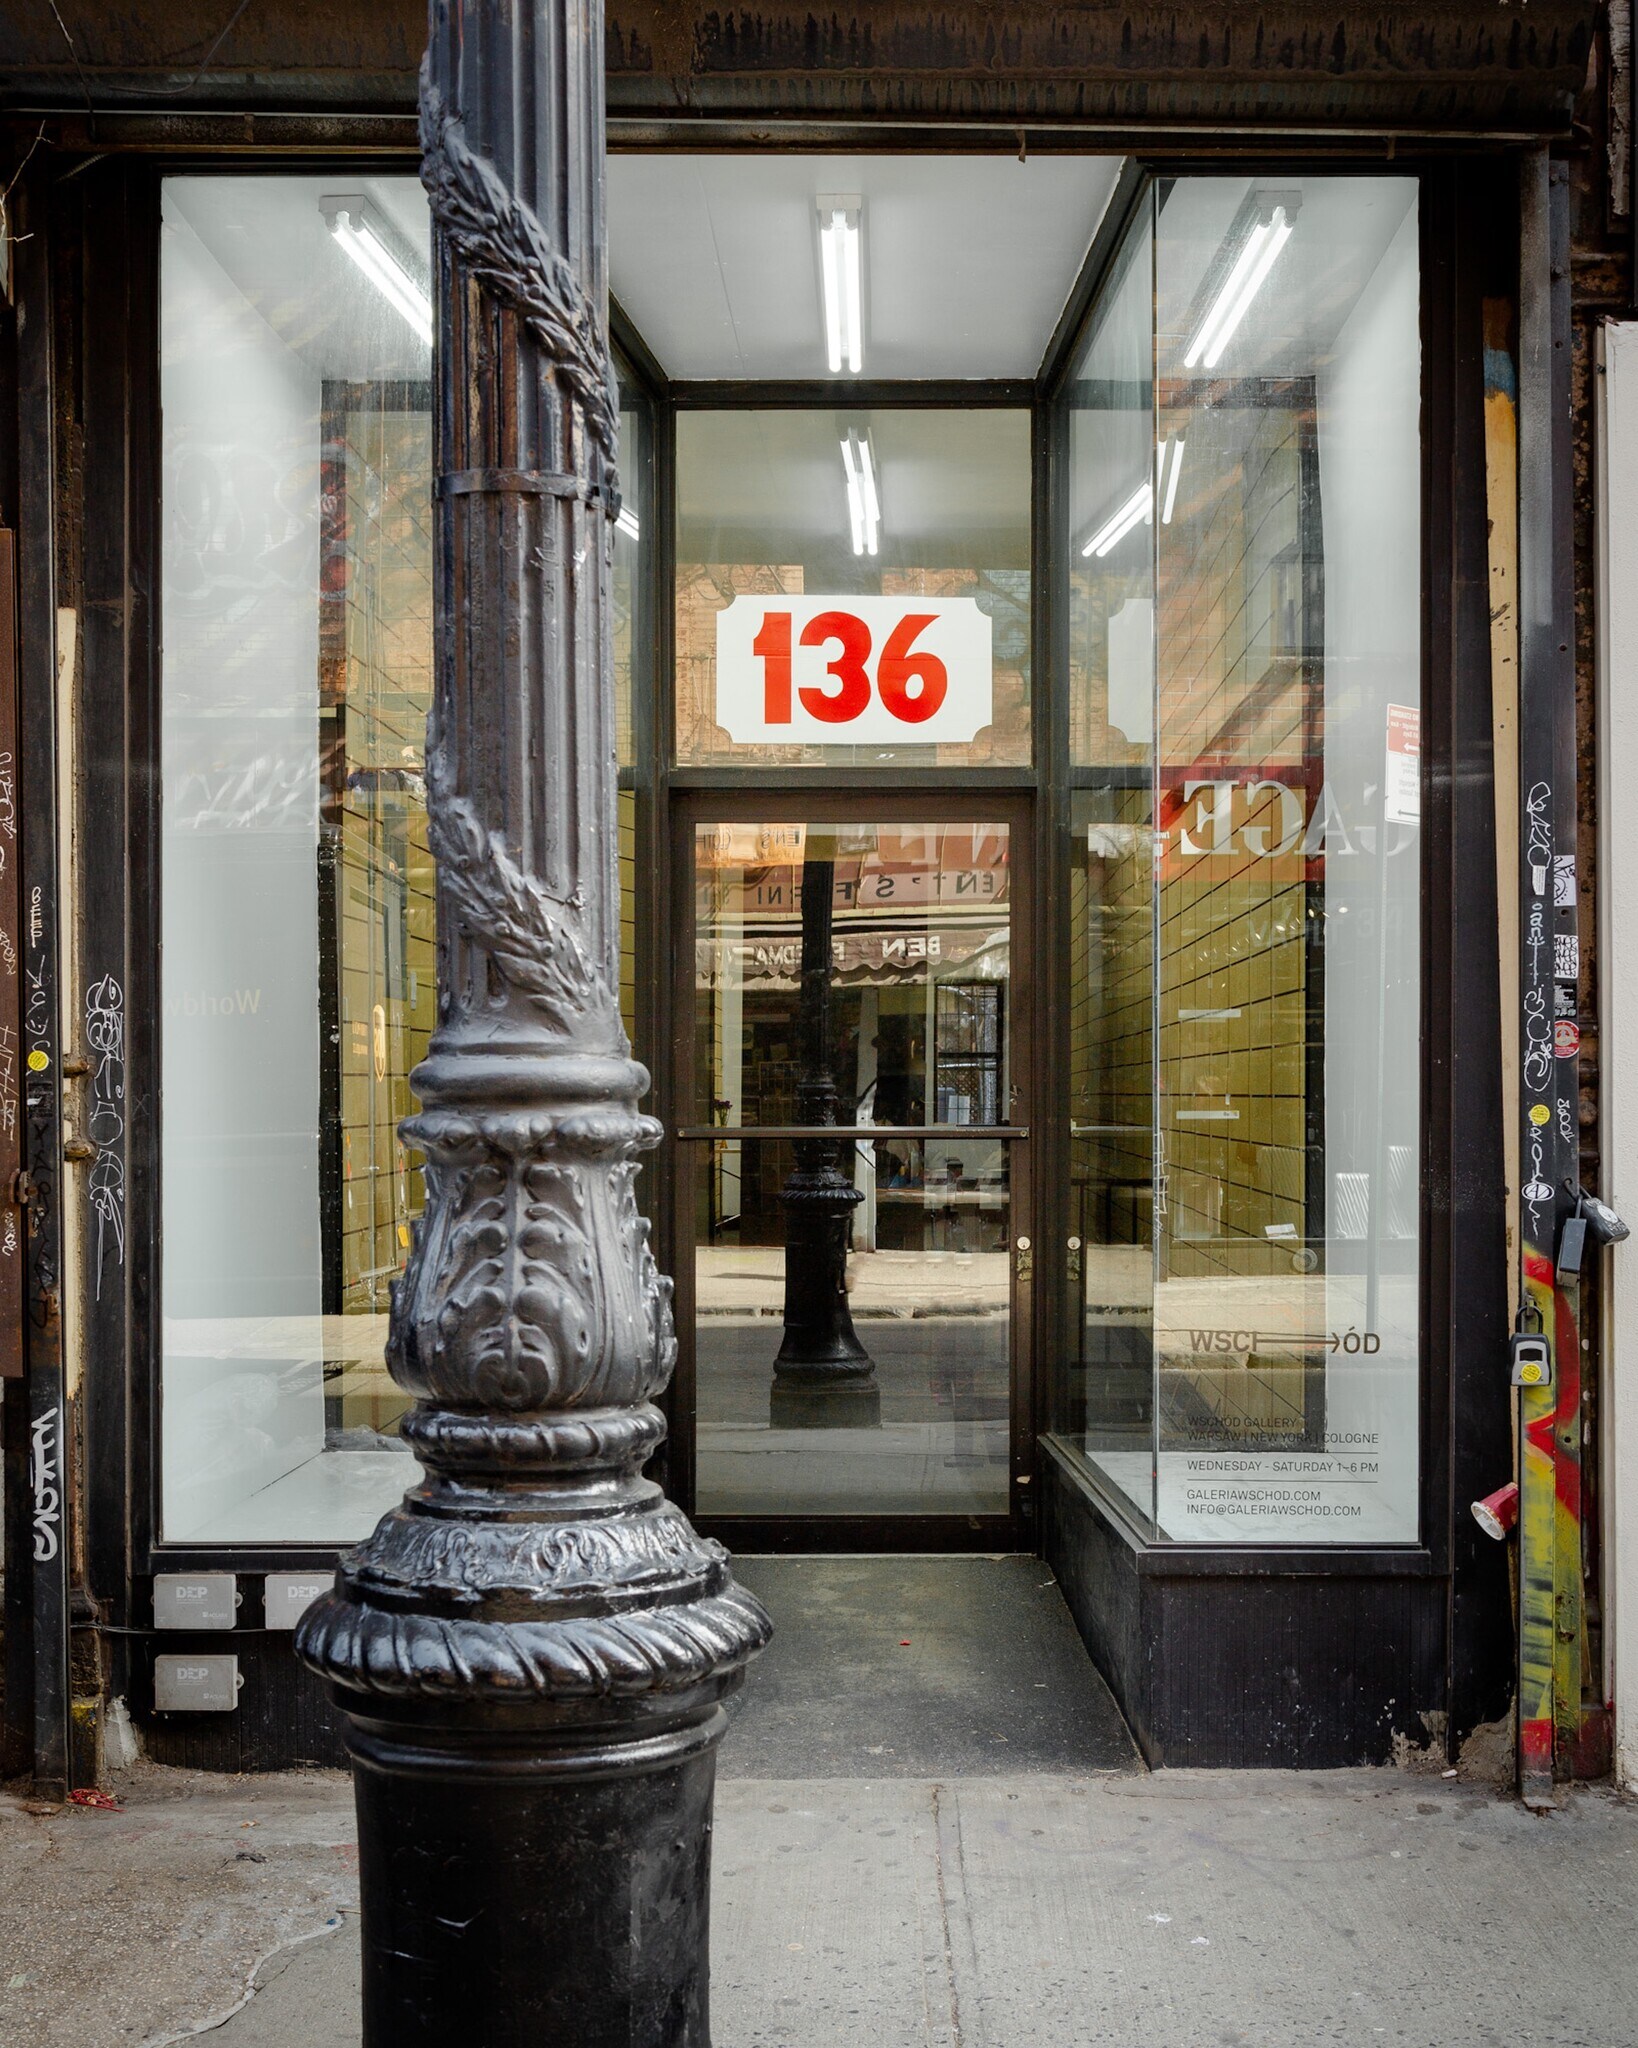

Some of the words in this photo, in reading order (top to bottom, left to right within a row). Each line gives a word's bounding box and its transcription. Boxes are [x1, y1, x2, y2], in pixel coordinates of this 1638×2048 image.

[752, 610, 949, 725] 136
[1243, 1417, 1298, 1428] GALLERY
[1187, 1431, 1241, 1442] WARSAW
[1250, 1432, 1279, 1443] NEW
[1280, 1432, 1312, 1443] YORK
[1323, 1432, 1379, 1444] COLOGNE
[1187, 1460, 1262, 1471] WEDNESDAY
[1272, 1461, 1334, 1472] SATURDAY
[1360, 1462, 1379, 1473] PM
[1186, 1489, 1321, 1501] GALERIAWSCHOD.COM
[1186, 1503, 1361, 1516] INFO@GALERIAWSCHOD.COM
[175, 1586, 208, 1599] DEP
[287, 1585, 320, 1599] DEP
[176, 1667, 209, 1680] DEP
